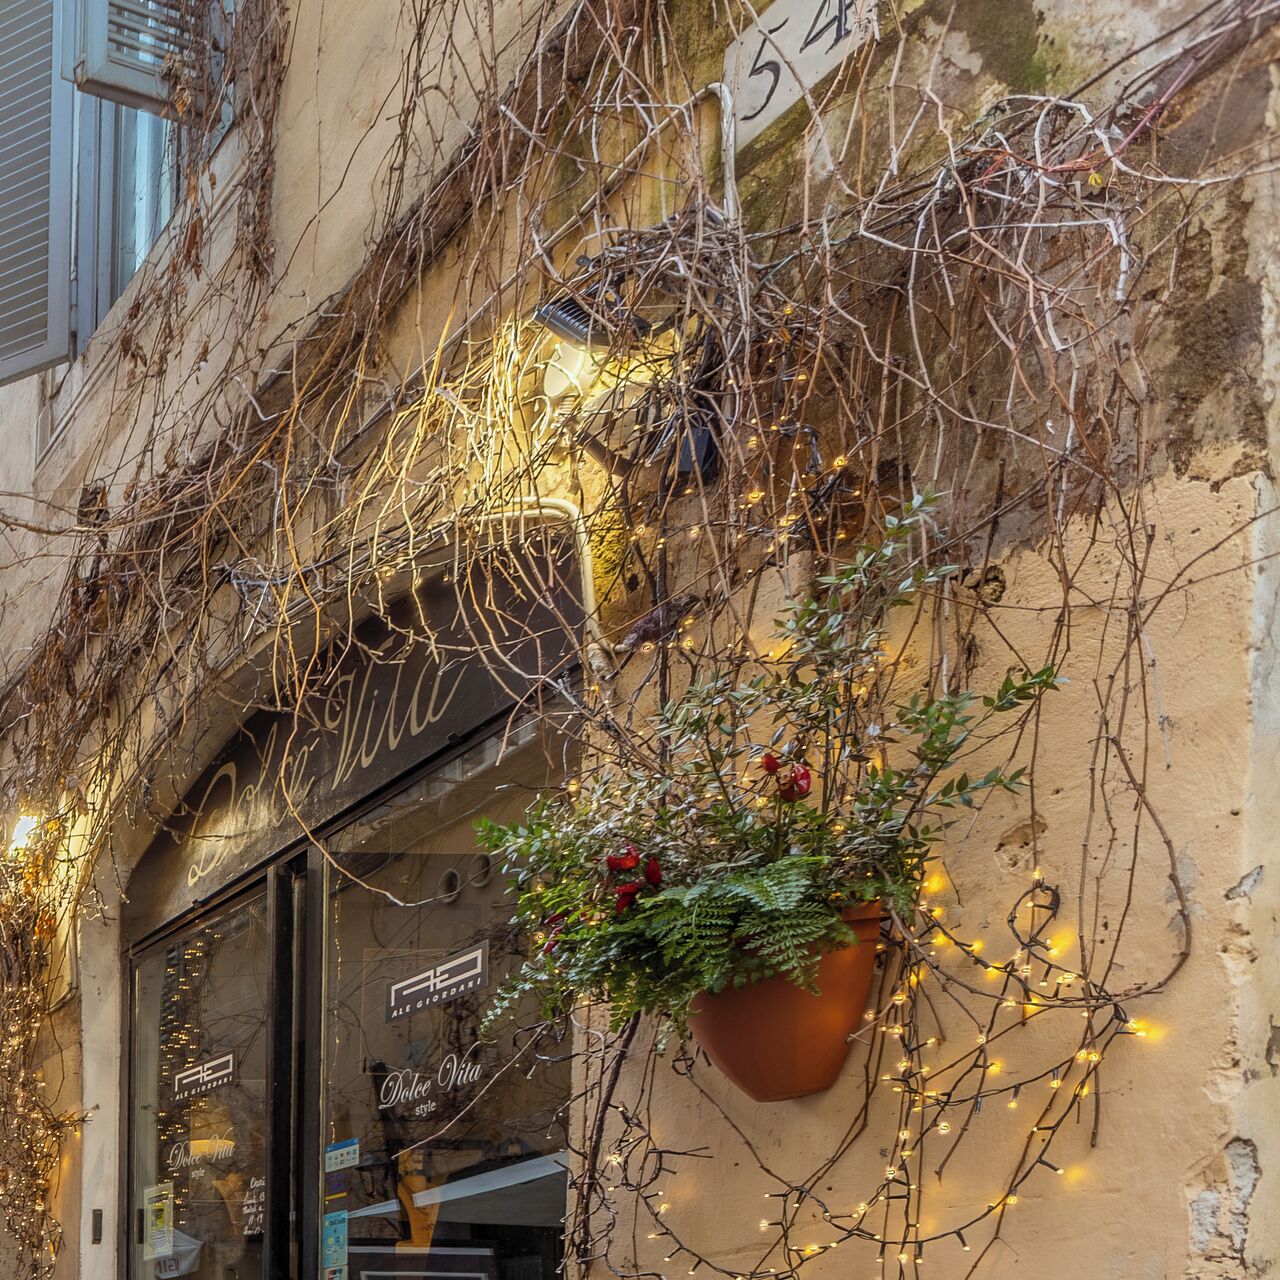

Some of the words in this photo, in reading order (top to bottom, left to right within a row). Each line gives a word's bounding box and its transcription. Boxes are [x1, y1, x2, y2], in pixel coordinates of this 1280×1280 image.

[391, 1004, 412, 1019] ALE
[416, 977, 482, 1009] GIORDANI
[175, 1091, 189, 1101] ALE
[190, 1075, 233, 1096] GIORDANI
[378, 1068, 432, 1110] Dolce
[437, 1043, 482, 1093] Vita
[415, 1100, 437, 1117] style
[167, 1140, 202, 1172] Dolce
[206, 1127, 235, 1164] Vita
